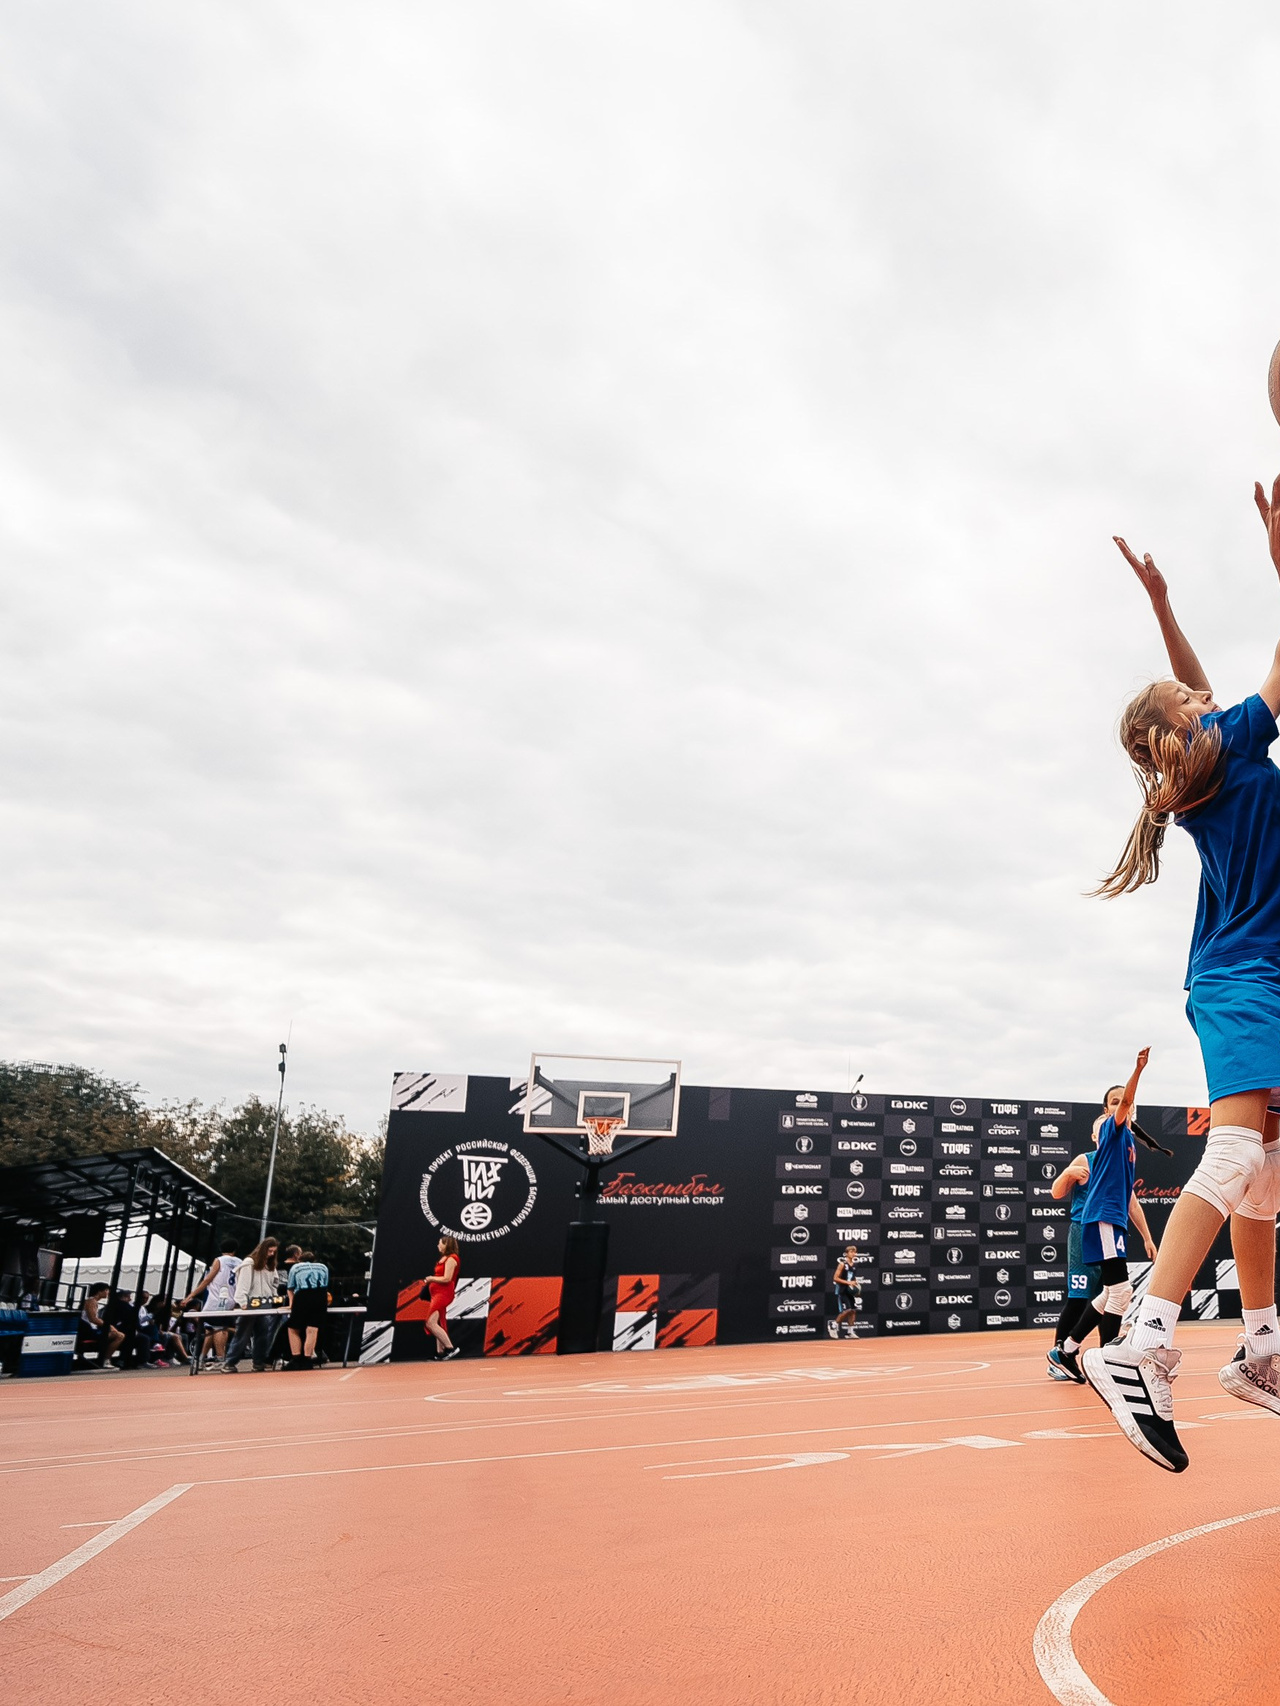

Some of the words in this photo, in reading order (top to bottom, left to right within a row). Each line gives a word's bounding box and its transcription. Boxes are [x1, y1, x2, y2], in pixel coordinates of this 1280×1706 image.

[904, 1100, 928, 1110] DKC
[455, 1139, 508, 1153] РОССИЙСКОЙ
[851, 1142, 877, 1150] DKC
[428, 1149, 453, 1172] ПРОЕКТ
[510, 1148, 537, 1184] ФЕДЕРАЦИИ
[603, 1172, 724, 1197] Баскетбол
[796, 1185, 822, 1194] DKC
[511, 1186, 537, 1227] БАСКЕТБОЛА
[630, 1195, 689, 1206] доступный
[692, 1196, 724, 1206] спорт
[997, 1251, 1020, 1259] DKC
[1071, 1275, 1087, 1289] 59
[949, 1295, 972, 1303] DKC
[777, 1304, 816, 1312] СПОРТ
[1144, 1321, 1166, 1333] adidas
[1239, 1362, 1279, 1397] adidas
